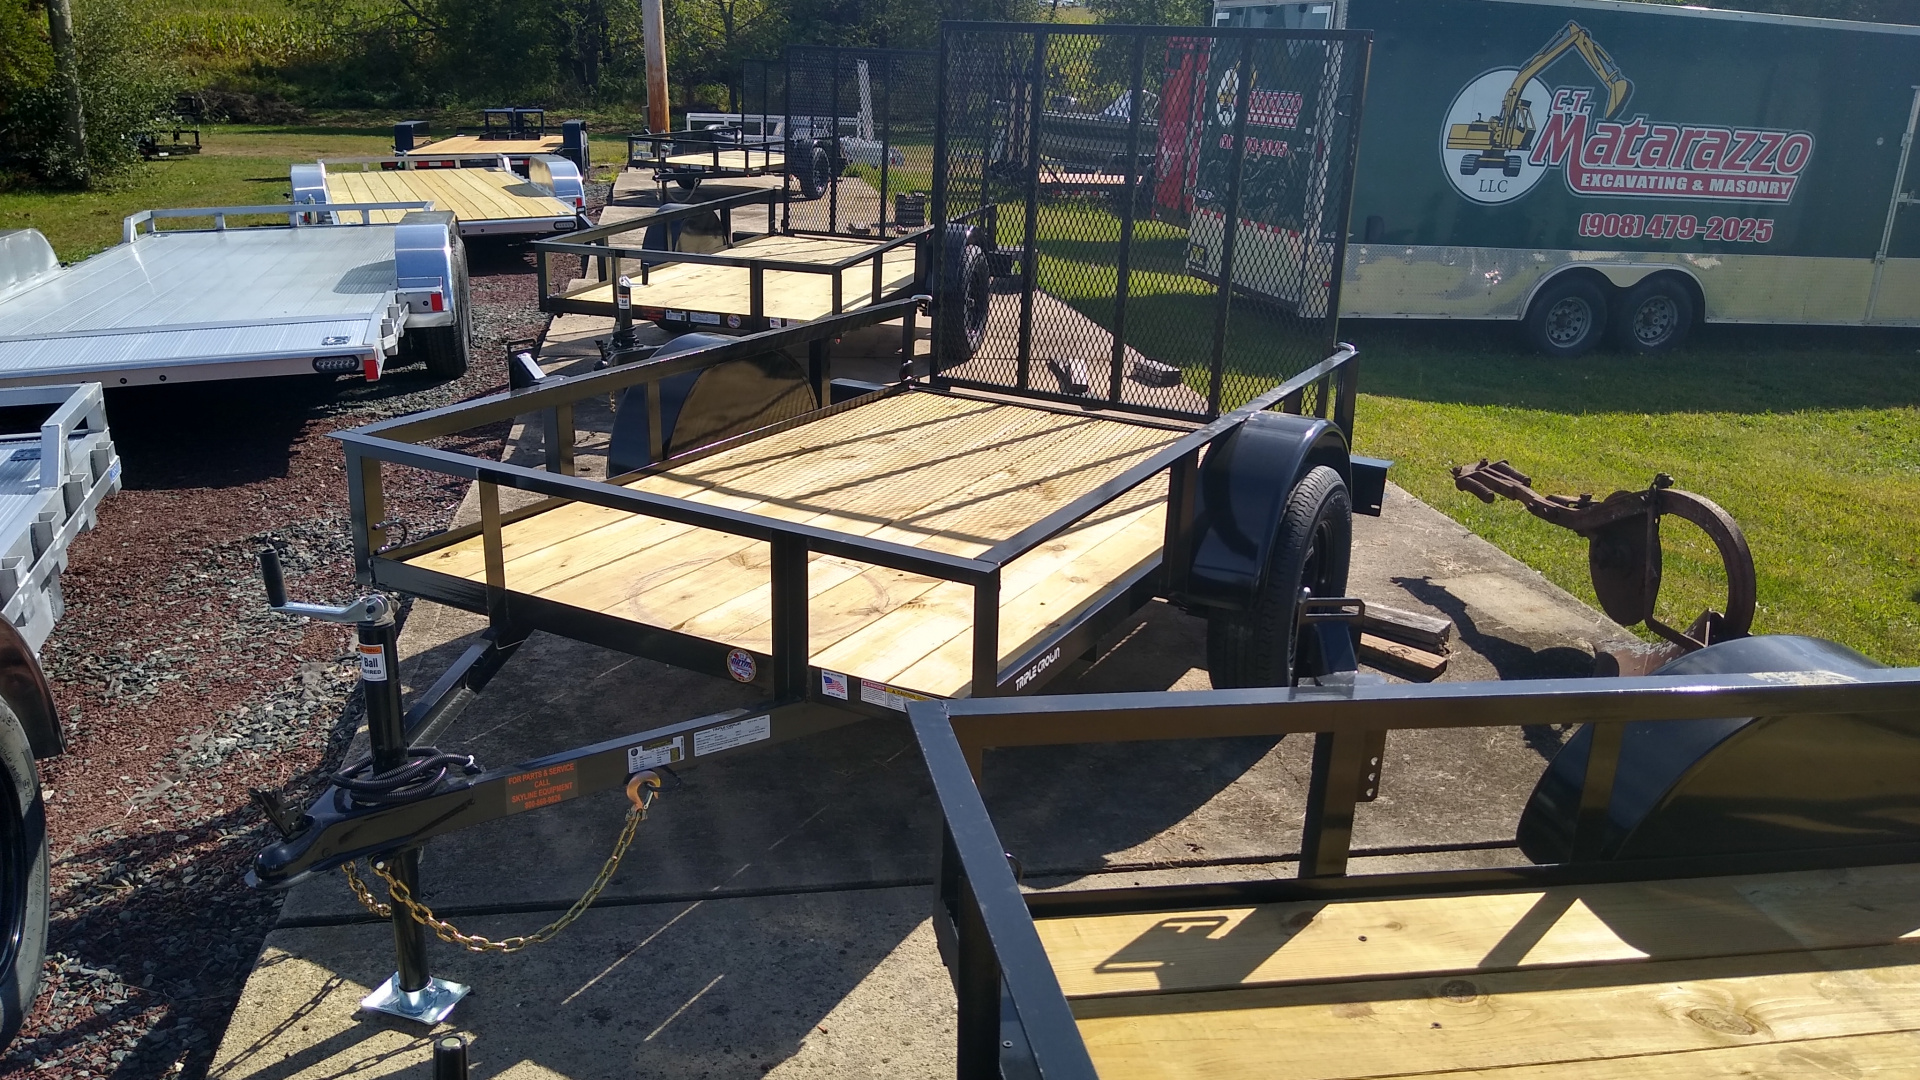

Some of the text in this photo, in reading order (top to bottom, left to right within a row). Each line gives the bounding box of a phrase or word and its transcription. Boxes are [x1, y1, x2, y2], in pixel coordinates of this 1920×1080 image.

[1551, 89, 1591, 114] C.T.
[1528, 112, 1813, 175] Matarazzo
[1478, 179, 1508, 193] LLC
[1580, 173, 1791, 195] EXCAVATING & MASONRY
[1578, 213, 1774, 243] (908) 479-2025
[364, 657, 378, 667] Ball
[1015, 647, 1060, 691] TRIPLE CROWN
[508, 775, 521, 784] FOR
[522, 770, 542, 781] PARTS
[548, 763, 574, 775] SERVICE
[534, 778, 550, 788] CALL
[511, 782, 573, 803] SKYLINE EQUIPMENT
